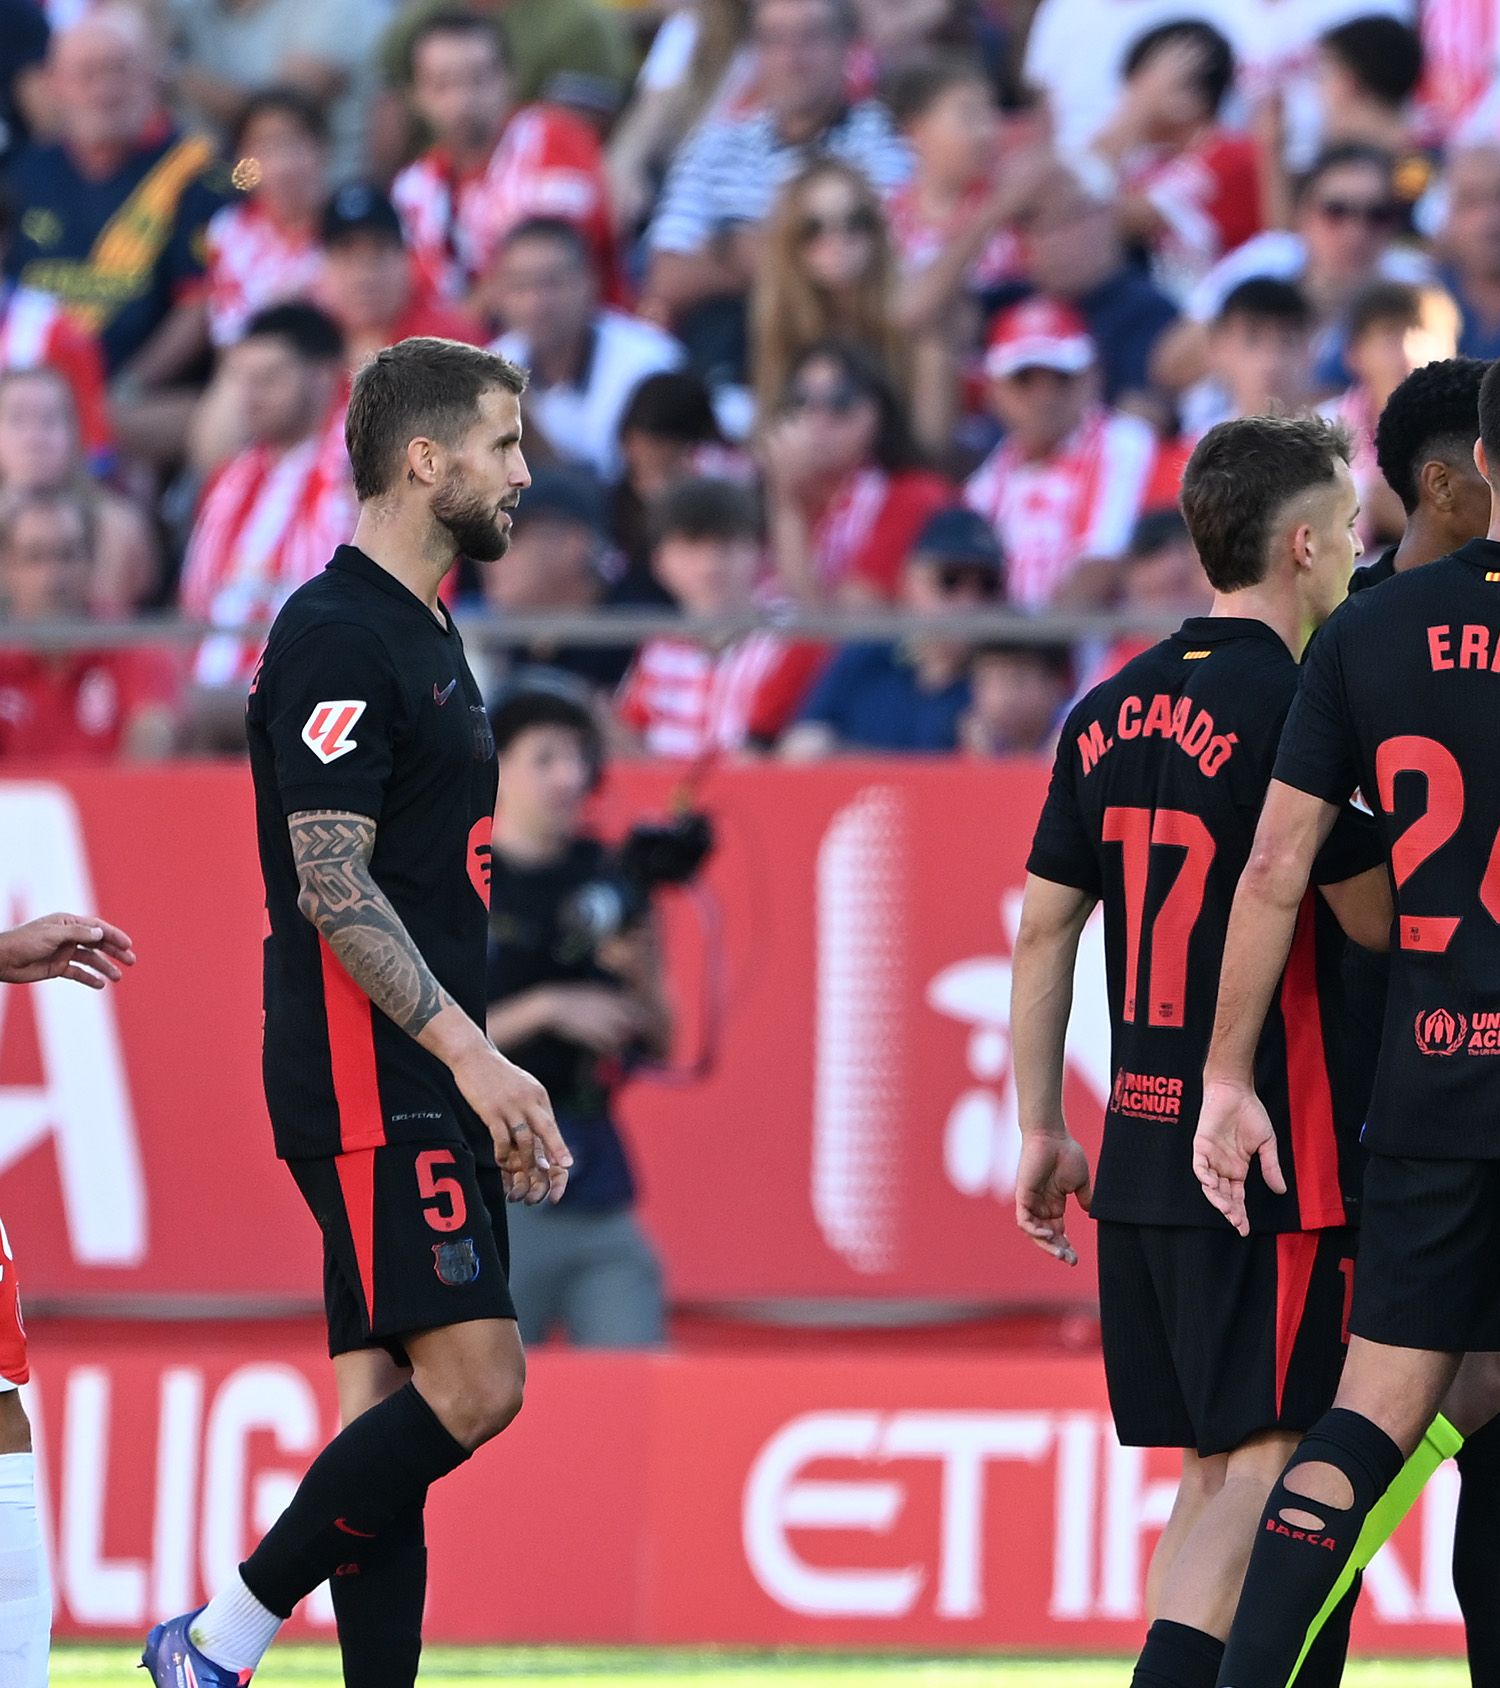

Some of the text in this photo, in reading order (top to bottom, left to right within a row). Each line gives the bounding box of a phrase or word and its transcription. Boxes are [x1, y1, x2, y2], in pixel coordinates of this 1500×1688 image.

[1076, 694, 1239, 777] M. CAADÓ
[1102, 807, 1217, 1027] 17
[1121, 1091, 1180, 1115] ACNUR
[415, 1149, 467, 1232] 5
